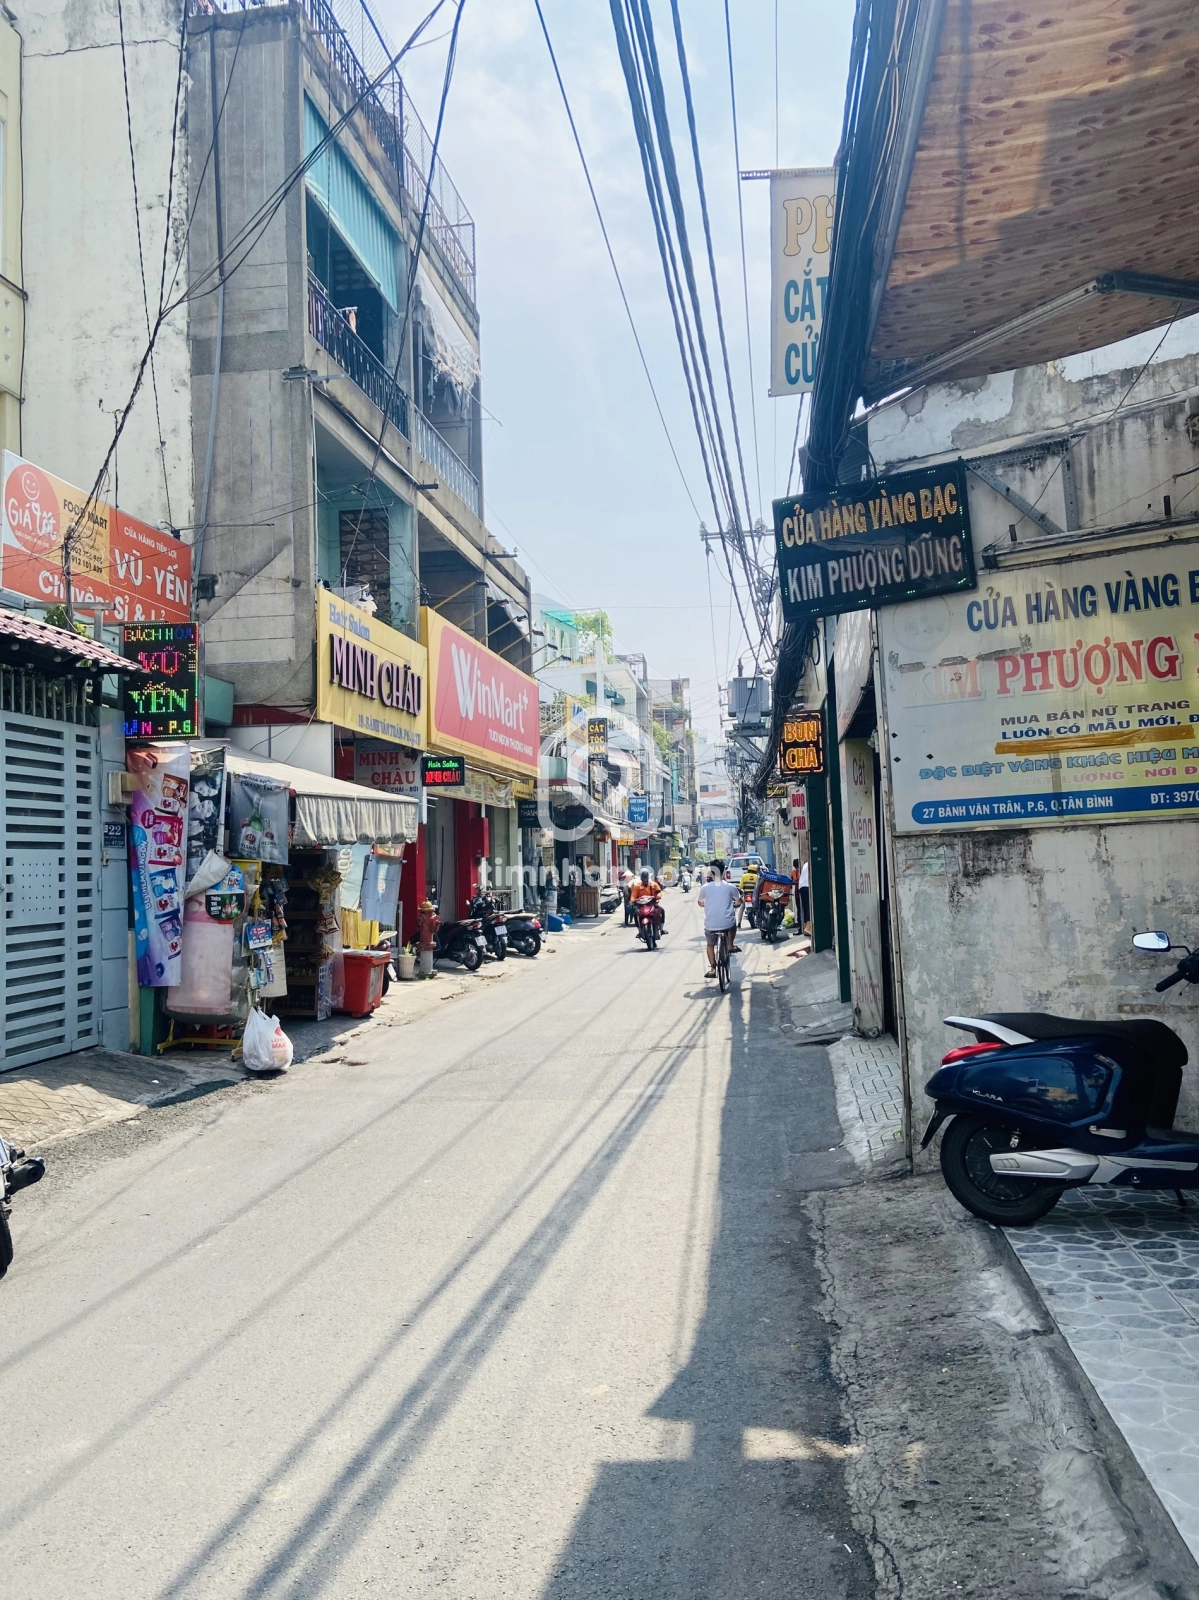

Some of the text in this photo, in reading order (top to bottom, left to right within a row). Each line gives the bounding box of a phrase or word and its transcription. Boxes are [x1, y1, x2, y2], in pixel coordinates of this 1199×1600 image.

[783, 195, 836, 256] PH
[63, 499, 107, 530] FOOD MART
[783, 482, 958, 548] CỬA HÀNG VÀNG BẠC
[124, 525, 137, 539] CỬA
[139, 533, 155, 548] HÀNG
[114, 547, 143, 586] VŨ
[153, 563, 188, 606] YẾN
[787, 531, 964, 604] KIM PHƯỢNG DŨNG
[967, 586, 1017, 632] CỬA
[1025, 581, 1097, 625] HÀNG
[1105, 570, 1180, 614] VÀNG
[328, 603, 371, 640] Hair Salon
[329, 634, 423, 717] MINH CHÂU
[995, 635, 1179, 695] PHƯỢNG
[1000, 699, 1190, 726] MUA BÁN NỮ TRANG
[1001, 726, 1050, 739] LUÔN
[1056, 722, 1081, 735] CÓ
[1088, 717, 1131, 732] MẪU
[1138, 714, 1182, 728] MỚI,
[358, 751, 399, 766] MINH
[428, 760, 441, 768] Hair
[589, 745, 605, 753] NAM
[919, 766, 957, 780] ĐẶC
[962, 762, 1004, 777] BIỆT
[1008, 757, 1061, 773] VÀNG
[1067, 752, 1122, 768] KHÁC
[1127, 748, 1176, 764] HIỆU
[371, 768, 416, 785] CHÂU
[442, 768, 460, 783] CHÂU
[852, 752, 866, 786] Cắt
[1144, 765, 1177, 778] NƠI
[791, 789, 806, 808] BÚN
[922, 808, 935, 820] 27
[938, 804, 966, 818] BÀNH
[968, 802, 991, 816] VĂN
[993, 801, 1024, 815] TRÂN,
[1028, 801, 1048, 813] P.6,
[1051, 795, 1083, 811] Q.TÂN
[1087, 794, 1113, 808] BÌNH
[1150, 790, 1170, 804] ĐT:
[850, 806, 873, 847] Kiếng
[855, 867, 872, 894] Làm
[972, 1089, 1004, 1102] KLARA
